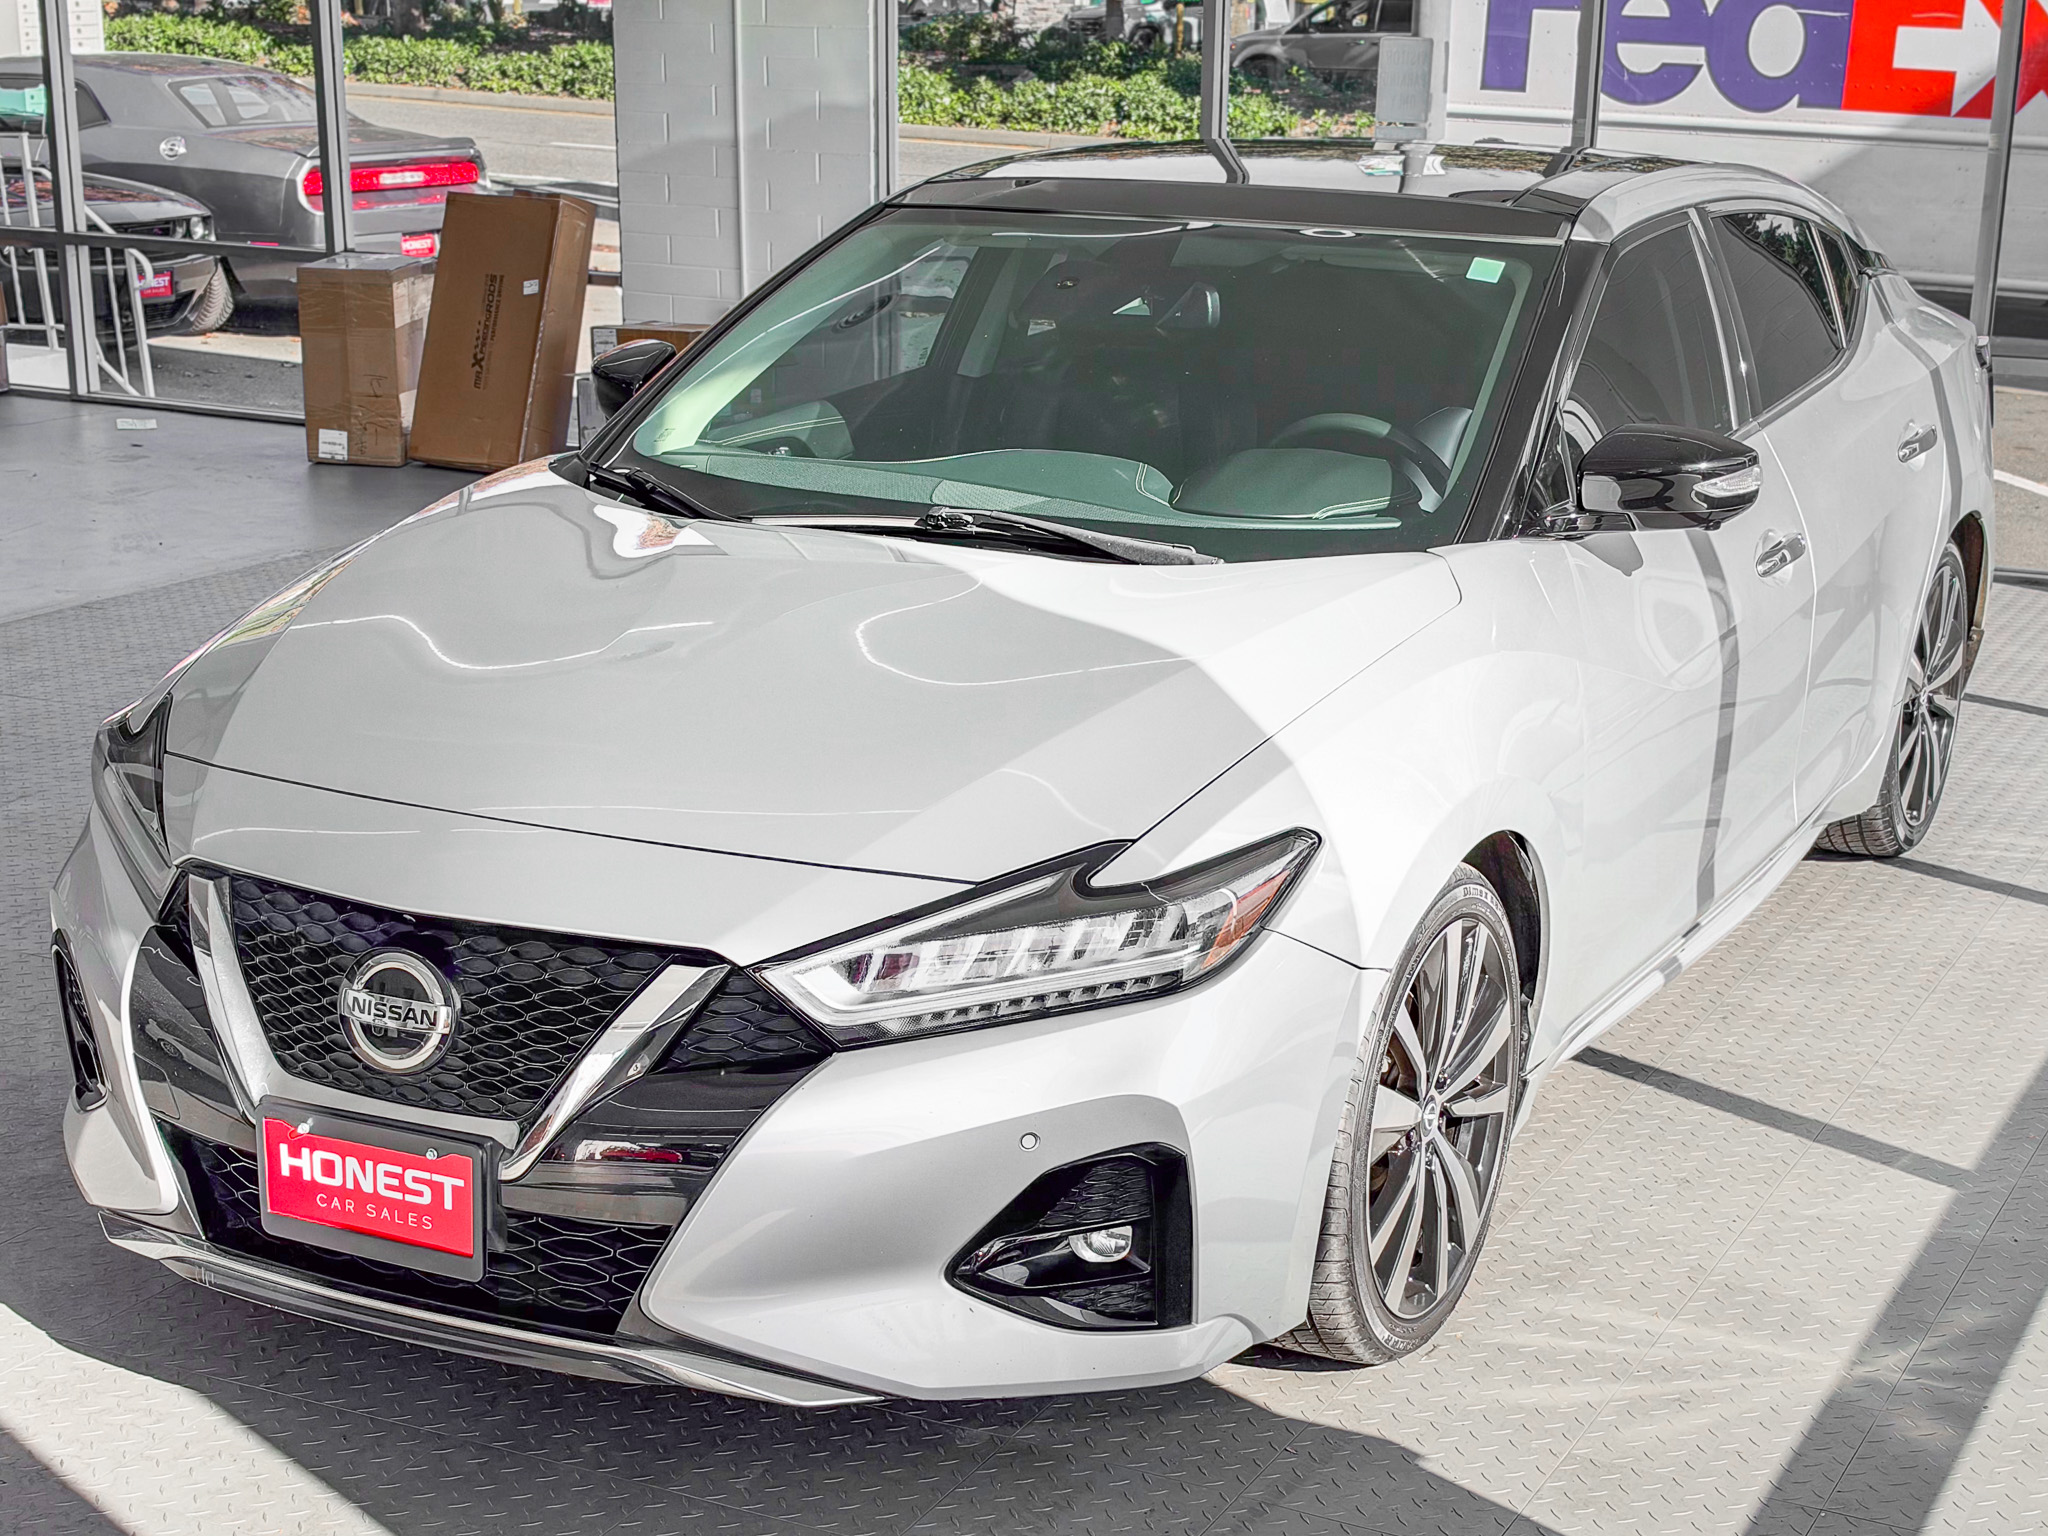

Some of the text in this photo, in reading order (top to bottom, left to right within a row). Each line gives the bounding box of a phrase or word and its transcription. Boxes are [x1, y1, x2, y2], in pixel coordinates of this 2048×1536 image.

[351, 995, 437, 1026] NISSAN
[279, 1142, 465, 1211] HONEST
[316, 1193, 434, 1231] CAR SALES
